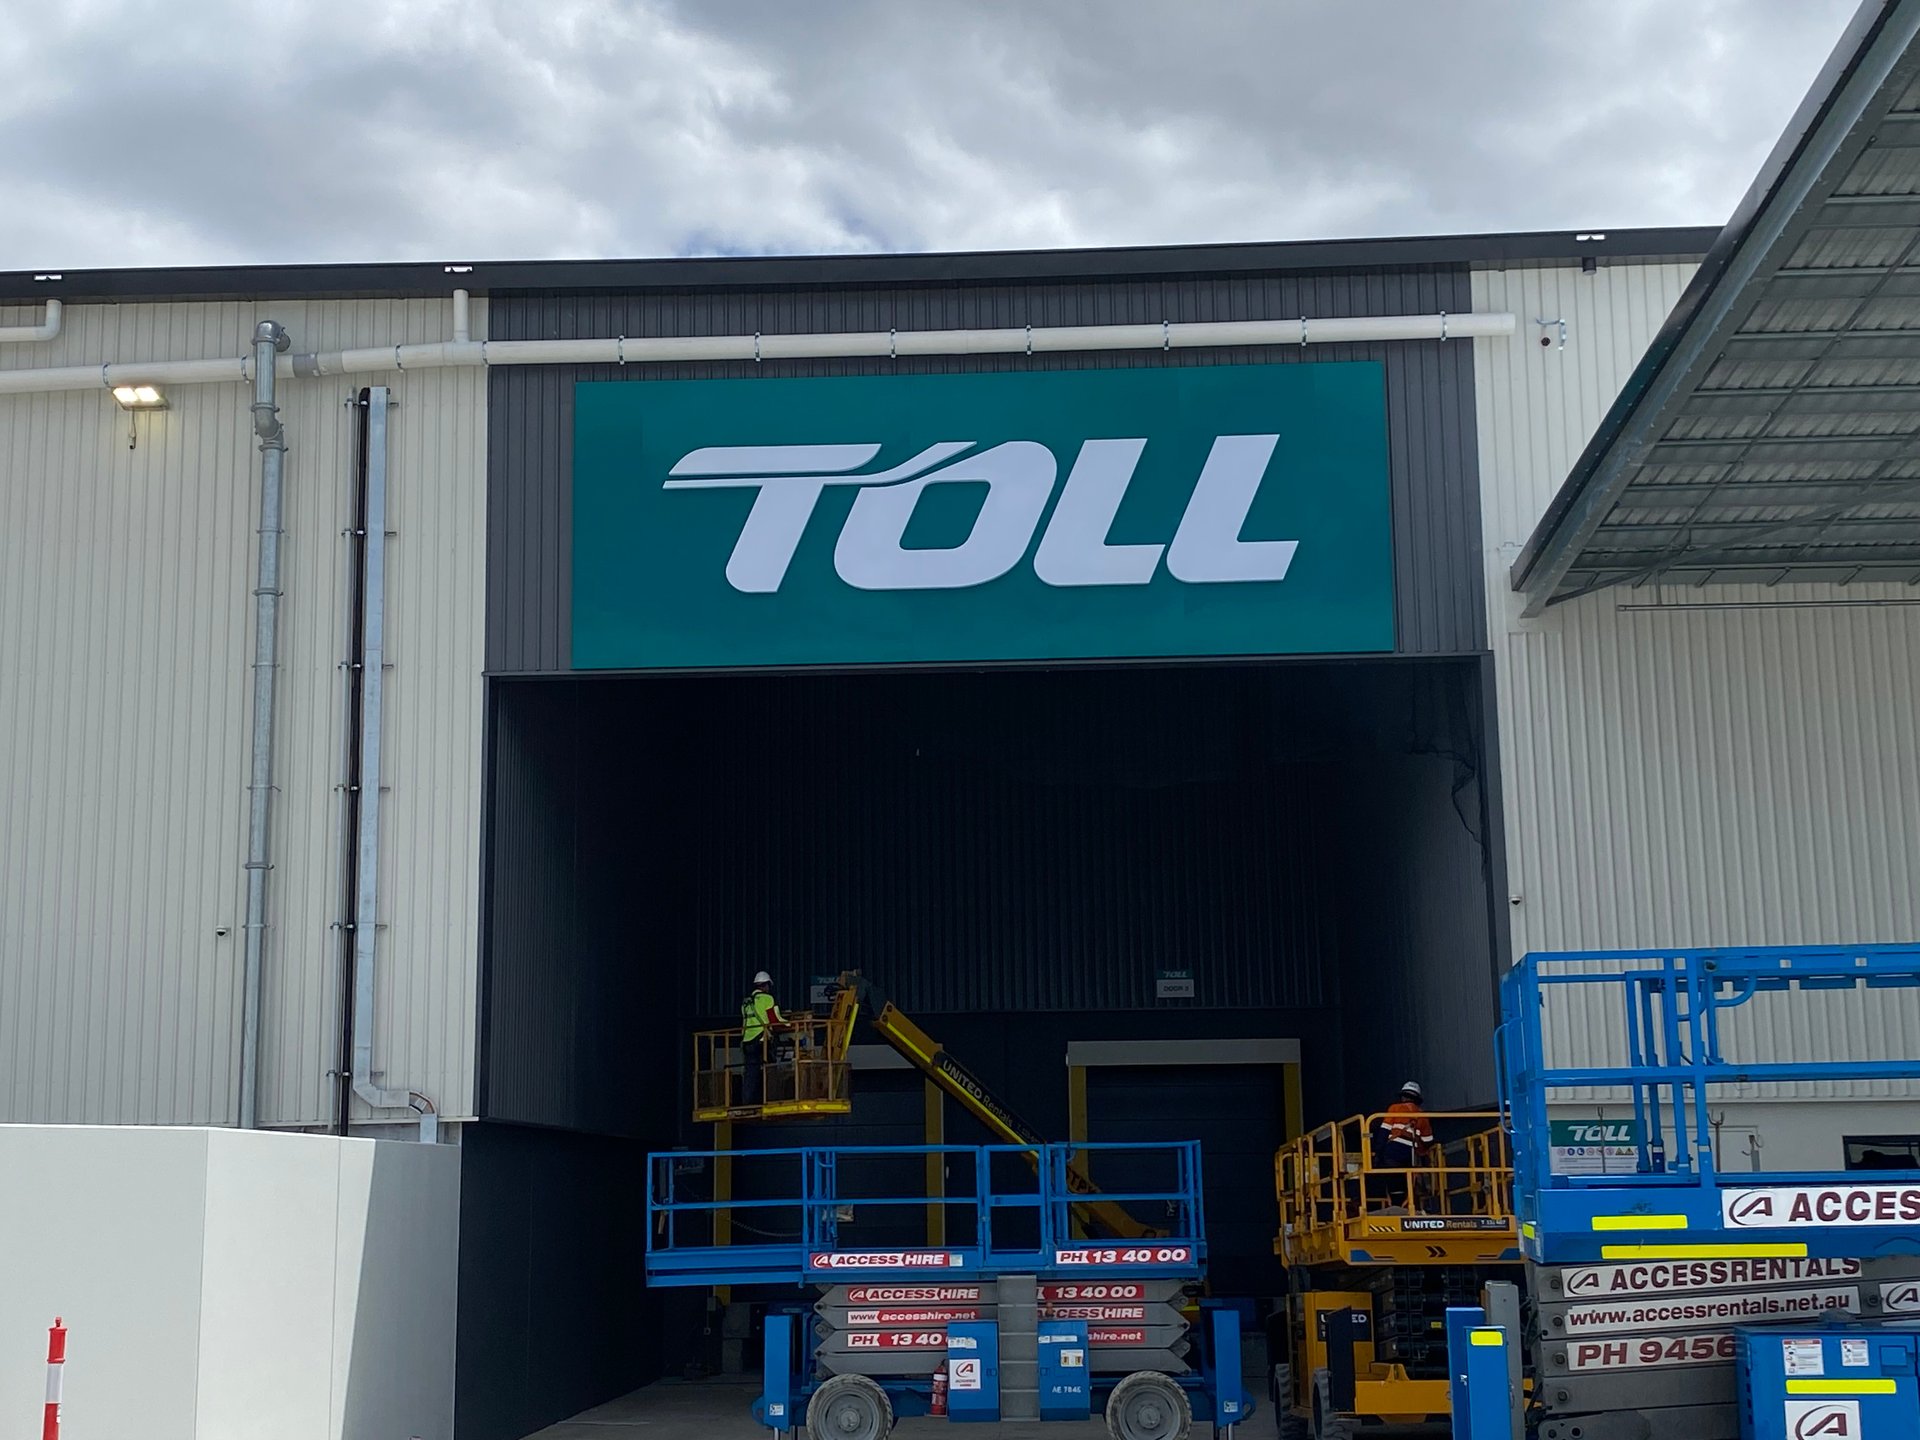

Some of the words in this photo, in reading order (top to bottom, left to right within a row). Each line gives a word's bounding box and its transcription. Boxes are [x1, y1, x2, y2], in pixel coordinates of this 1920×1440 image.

[662, 434, 1300, 593] TOLL
[942, 1059, 983, 1099] UNITED
[982, 1095, 1014, 1127] Rentals
[1567, 1125, 1631, 1142] TOLL
[1404, 1220, 1445, 1229] UNITED
[1446, 1220, 1477, 1229] Rentals
[836, 1254, 899, 1265] ACCESS
[904, 1254, 945, 1265] HIRE
[1060, 1252, 1083, 1262] PH
[1092, 1250, 1118, 1263] 13
[1121, 1249, 1152, 1262] 40
[1156, 1248, 1187, 1262] 00
[1610, 1258, 1861, 1292] ACCESSRENTALS
[869, 1289, 936, 1300] ACCESS
[939, 1288, 979, 1300] HIRE
[1056, 1286, 1078, 1299] 13
[1080, 1286, 1107, 1298] 40
[1110, 1285, 1137, 1298] 00
[850, 1313, 876, 1321] www
[881, 1311, 976, 1321] accesshire.net
[1104, 1307, 1144, 1318] HIRE
[1569, 1294, 1850, 1326] www.accessrentals.net.au
[851, 1335, 875, 1345] PH
[890, 1334, 913, 1346] 13
[915, 1333, 942, 1345] 40
[1577, 1343, 1628, 1367] PH
[1639, 1336, 1736, 1365] 9456
